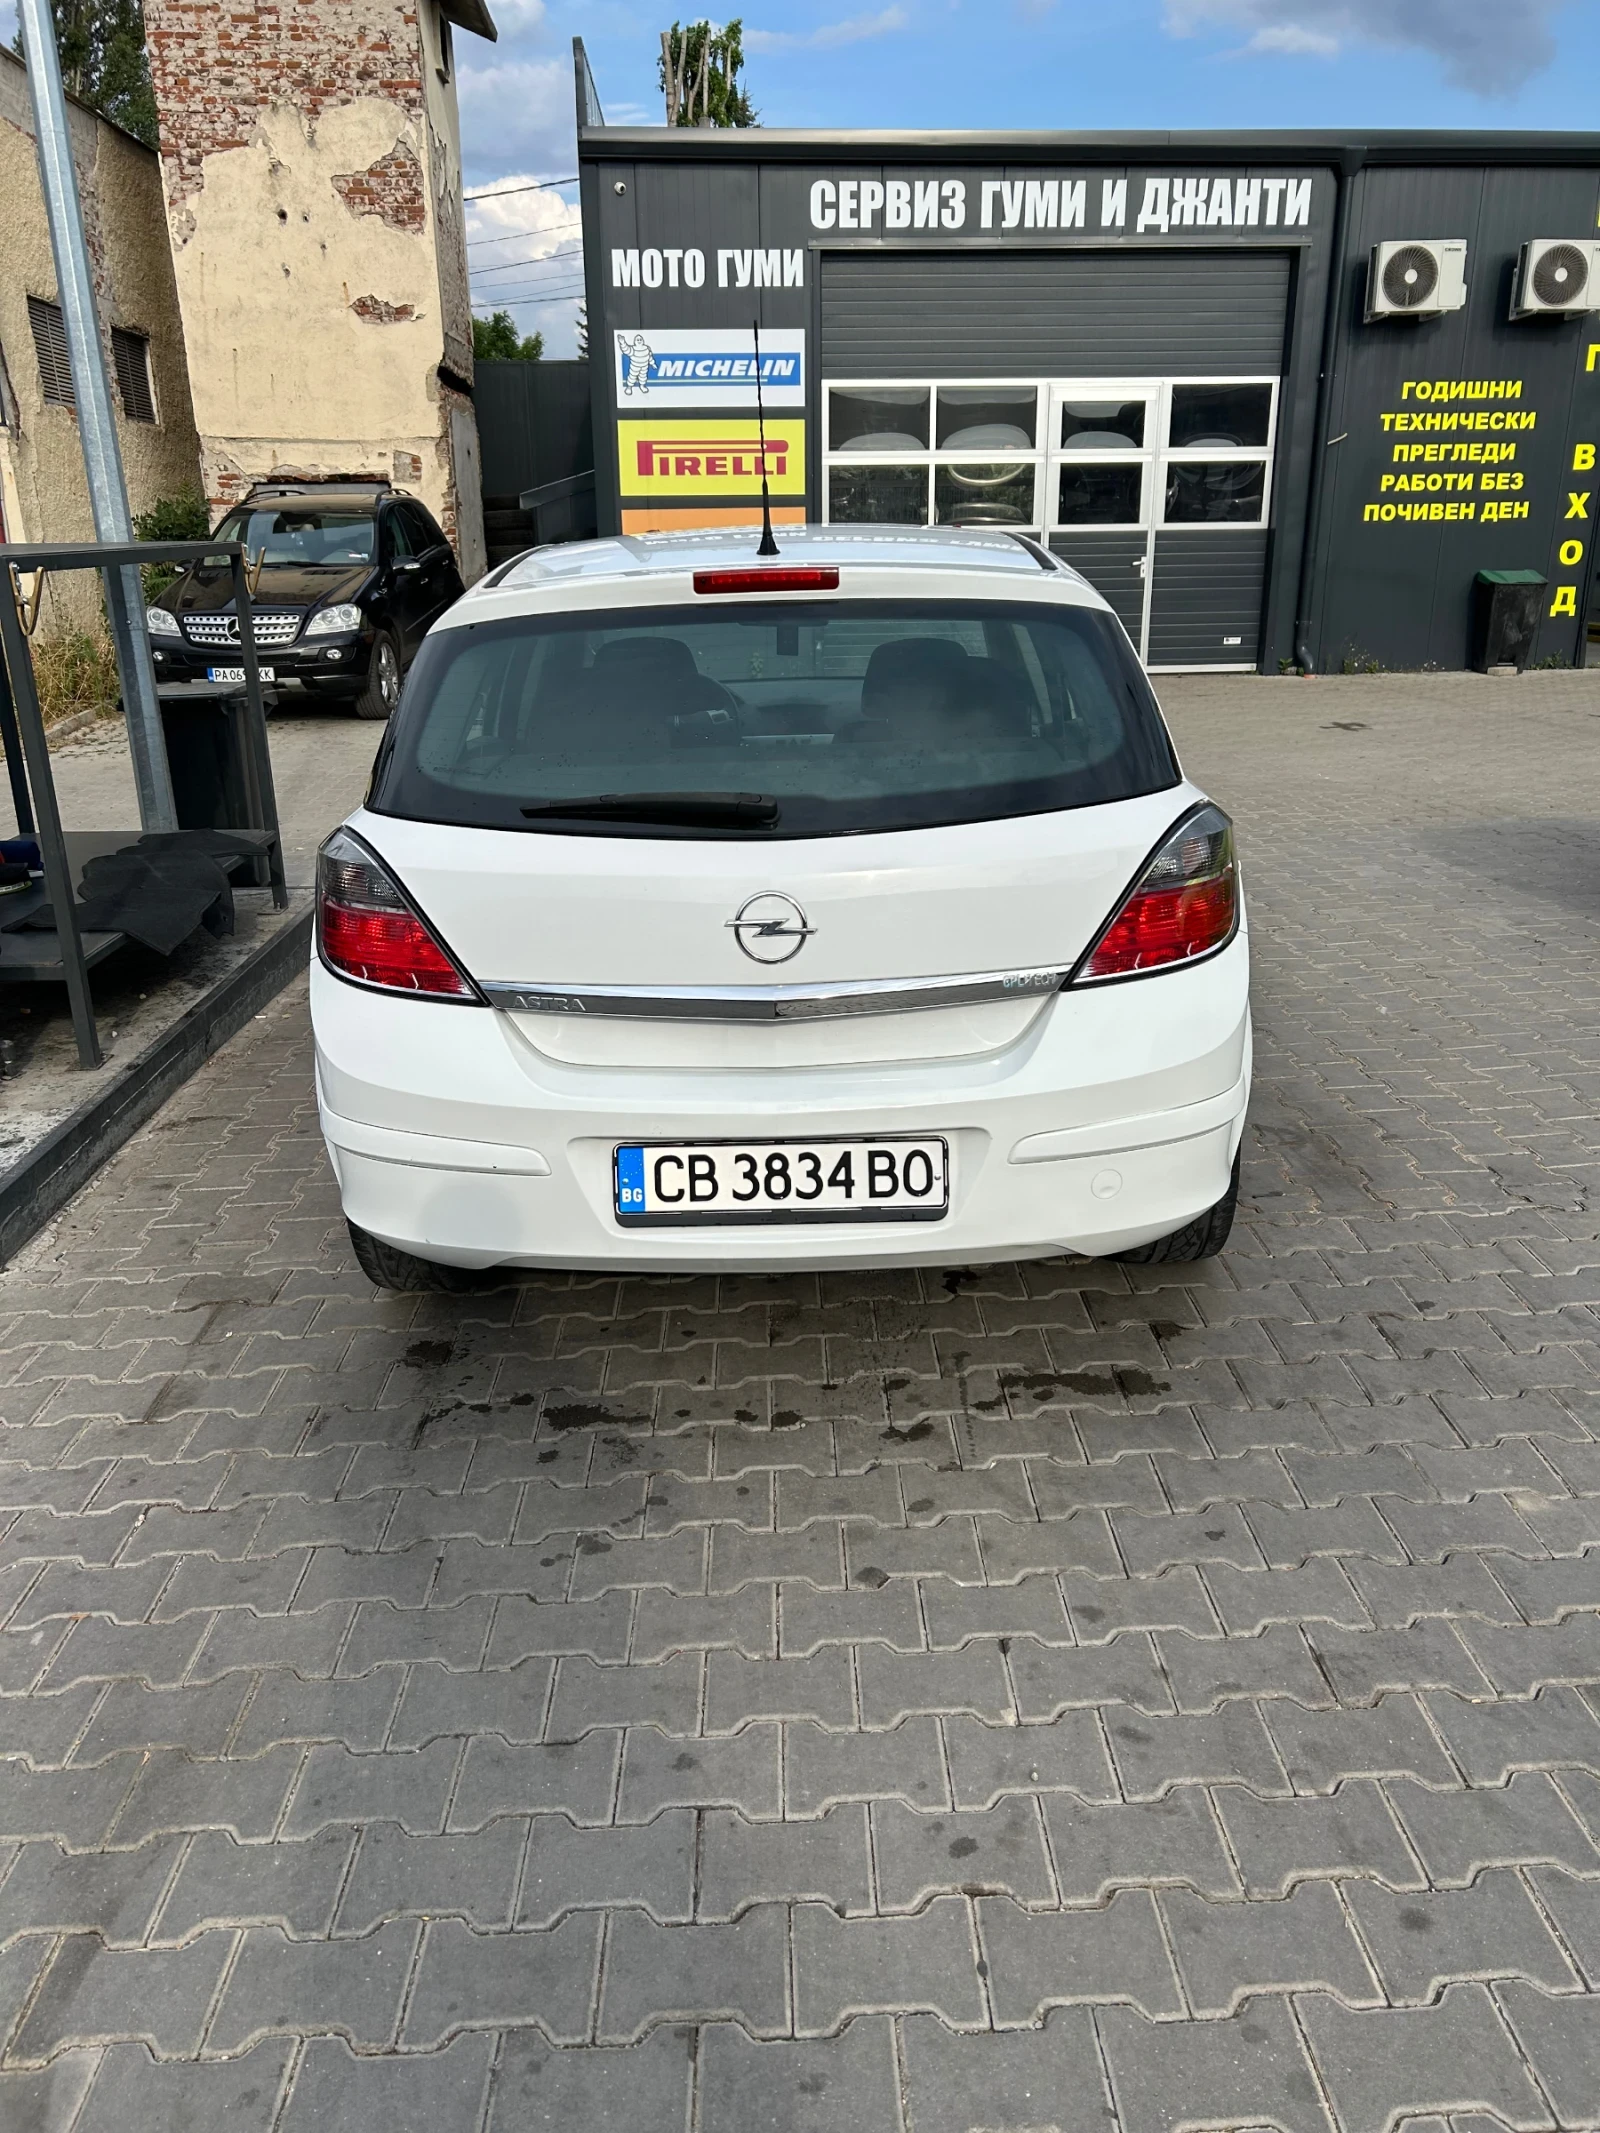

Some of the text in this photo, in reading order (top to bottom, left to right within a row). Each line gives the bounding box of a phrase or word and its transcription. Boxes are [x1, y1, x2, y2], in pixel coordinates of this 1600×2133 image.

[810, 177, 1313, 233] СЕРВИЗ ГУМИ И ДЖАНТИ
[611, 248, 804, 289] МОТО ГУМИ
[657, 359, 795, 377] MICHELIN
[1401, 380, 1523, 402] ГОДИШНИ
[1381, 411, 1537, 432] ТЕХНИЧЕСКИ
[637, 440, 789, 476] PIRELLI
[1392, 442, 1517, 463] ПРЕГЛЕДИ
[1380, 472, 1524, 492] РАБОТИ БЕЗ
[1363, 501, 1530, 522] ПОЧИВЕН ДЕН
[1549, 443, 1597, 617] ВХОД
[214, 669, 229, 680] PA
[511, 995, 587, 1011] ASTRA
[654, 1154, 719, 1203] CB
[732, 1151, 855, 1201] 3834
[621, 1187, 643, 1203] BG
